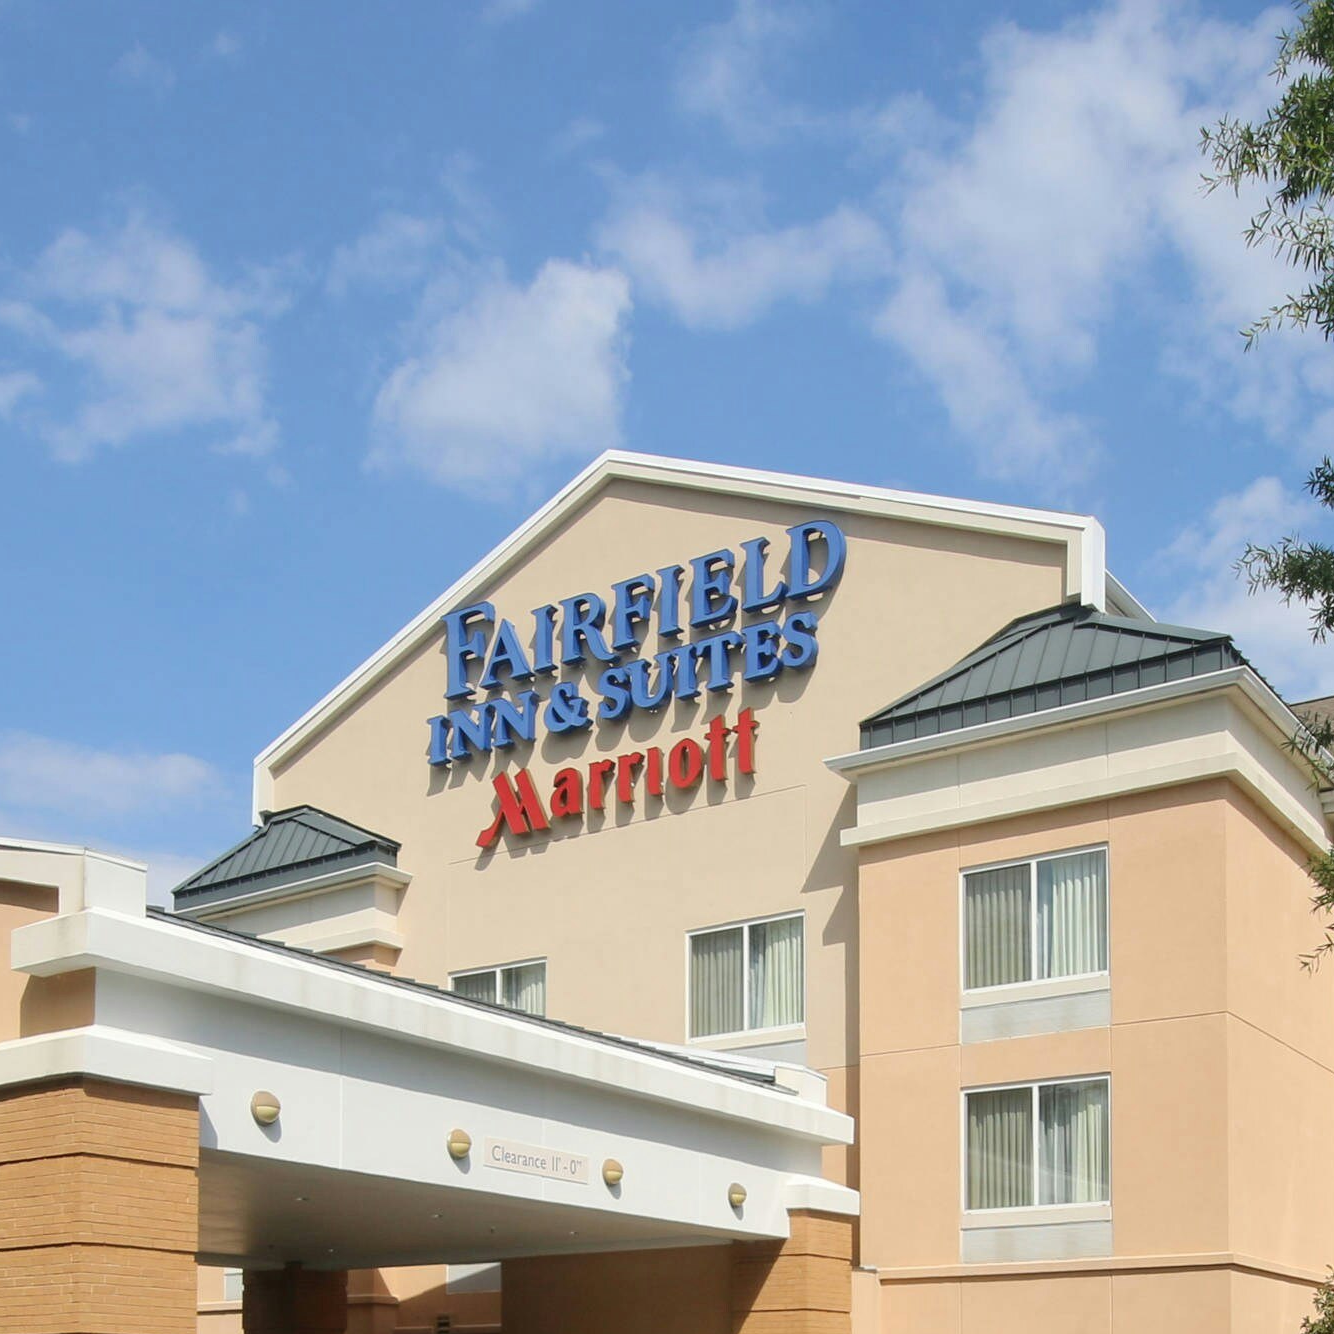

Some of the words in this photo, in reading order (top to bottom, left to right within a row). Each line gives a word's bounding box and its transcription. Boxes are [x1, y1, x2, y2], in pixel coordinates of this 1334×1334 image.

[441, 520, 847, 699] FAIRFIELD
[427, 690, 540, 766] INN
[543, 681, 594, 734] &
[598, 611, 819, 721] SUITES
[476, 707, 760, 848] Marriott
[491, 1145, 547, 1170] Clearance
